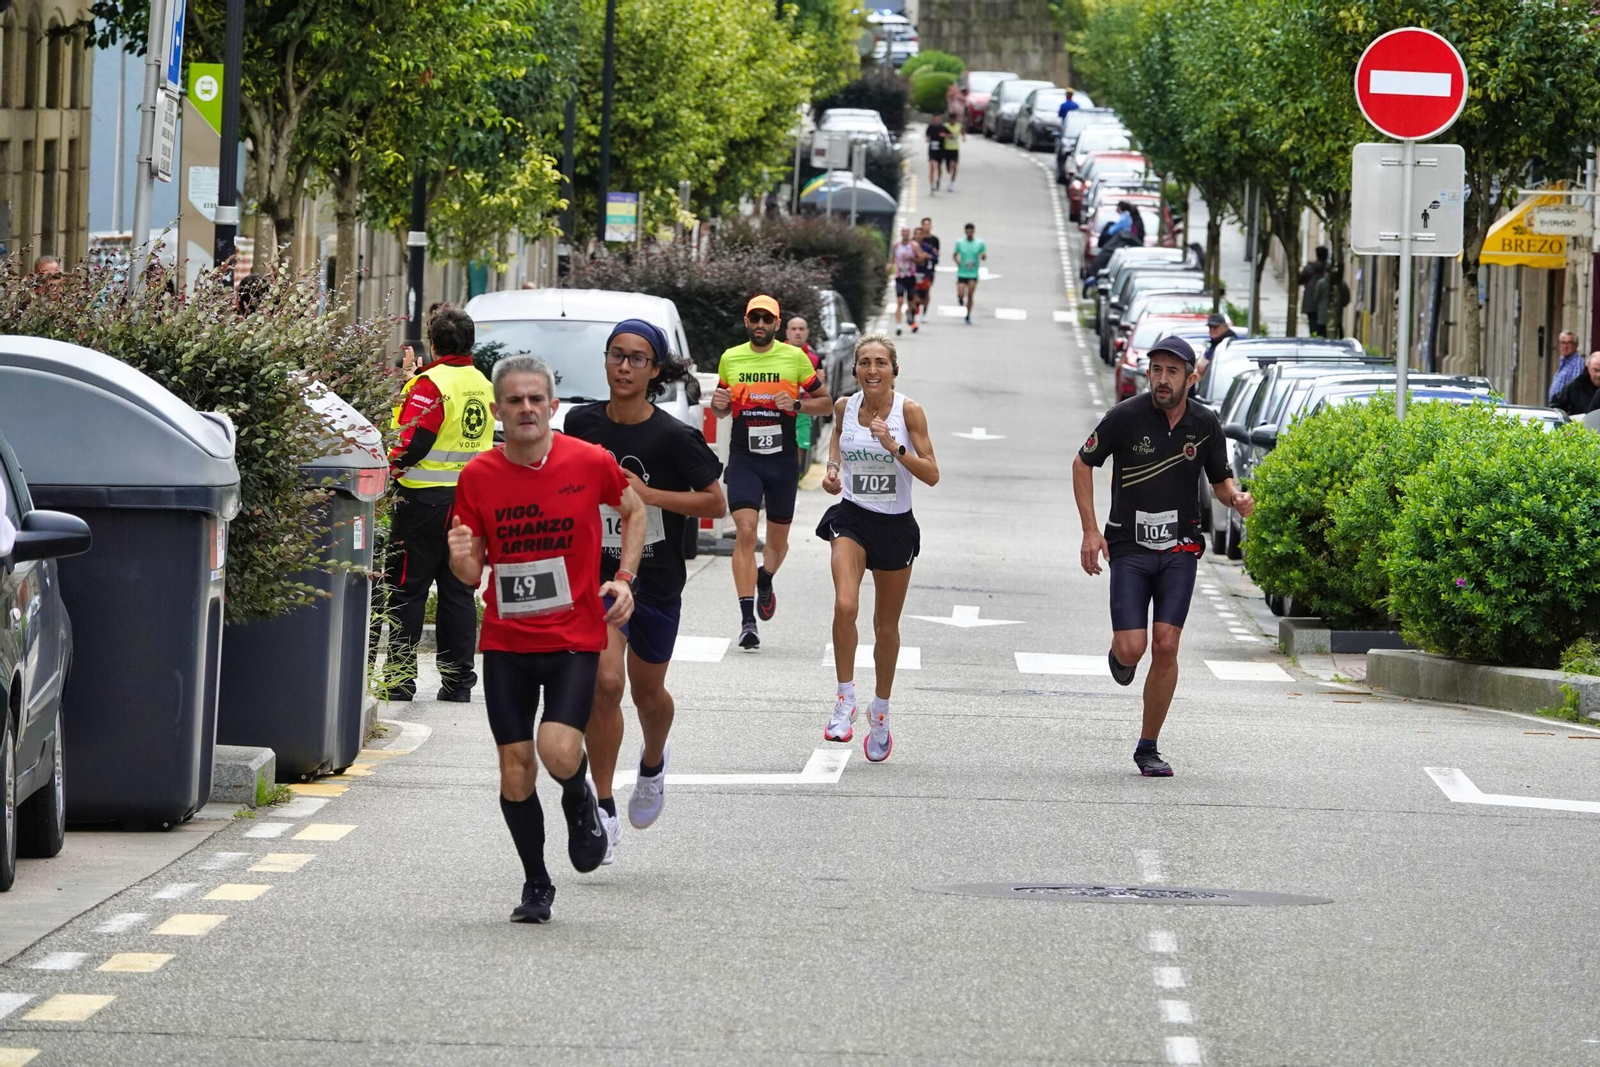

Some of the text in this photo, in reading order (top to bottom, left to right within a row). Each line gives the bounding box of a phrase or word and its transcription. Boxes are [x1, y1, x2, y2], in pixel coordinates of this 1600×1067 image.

[1501, 237, 1563, 254] BREZO
[738, 372, 780, 383] 3NORTH
[742, 410, 781, 418] xtrembike
[757, 435, 773, 447] 28
[859, 475, 890, 491] 702
[494, 503, 544, 522] VIGO,
[496, 517, 574, 539] CHANZO
[1143, 524, 1169, 540] 104
[500, 535, 573, 554] ARRIBA!
[513, 576, 536, 597] 49
